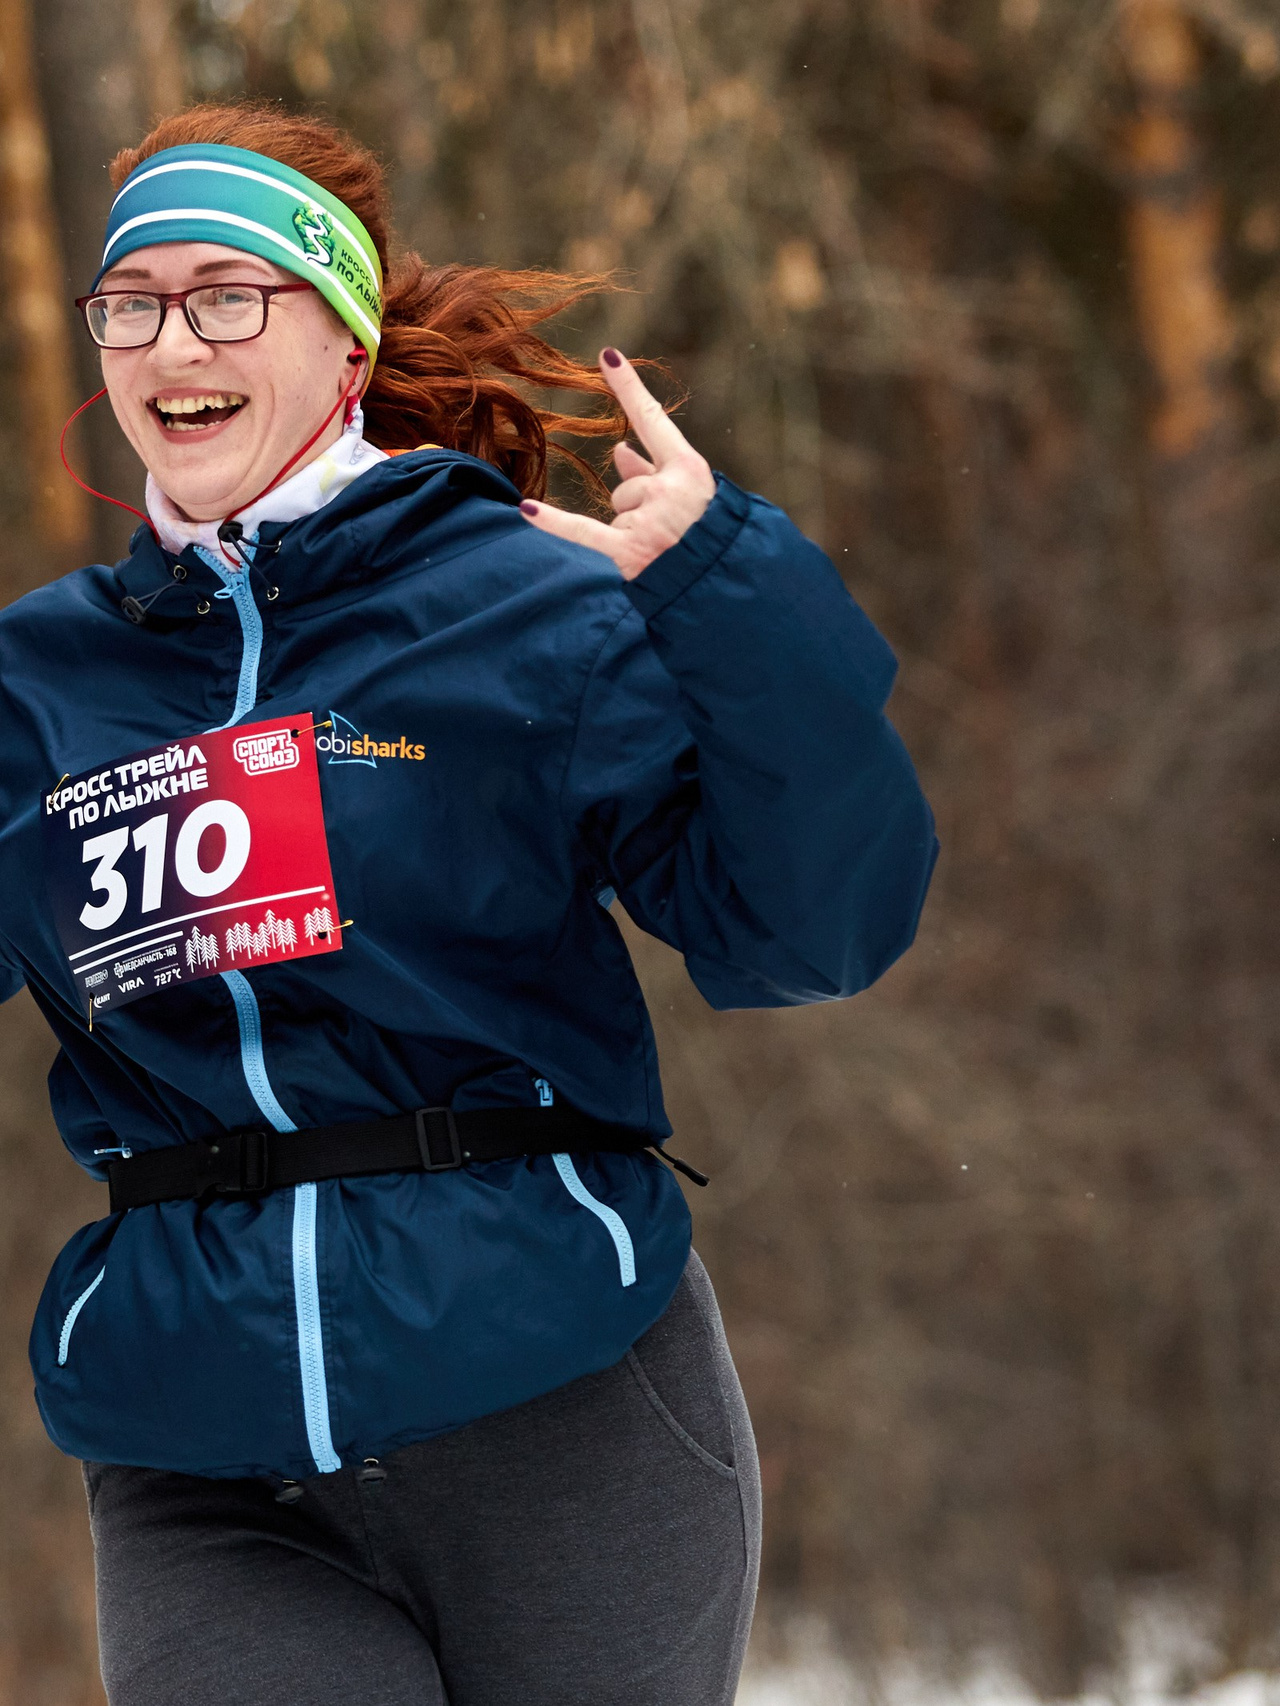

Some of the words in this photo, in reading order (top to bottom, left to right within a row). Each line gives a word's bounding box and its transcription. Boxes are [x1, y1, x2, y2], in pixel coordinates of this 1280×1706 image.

[336, 260, 355, 284] ПО
[341, 248, 372, 286] КРОСС
[237, 735, 287, 758] СПОРТ
[248, 748, 295, 771] СОЮЗ
[317, 731, 426, 761] obisharks
[46, 770, 113, 815] КРОСС
[114, 744, 208, 786] ТРЕЙЛ
[69, 801, 100, 830] ПО
[103, 767, 209, 818] ЛЫЖНЕ
[79, 799, 251, 931] 310
[118, 976, 145, 994] VIRA
